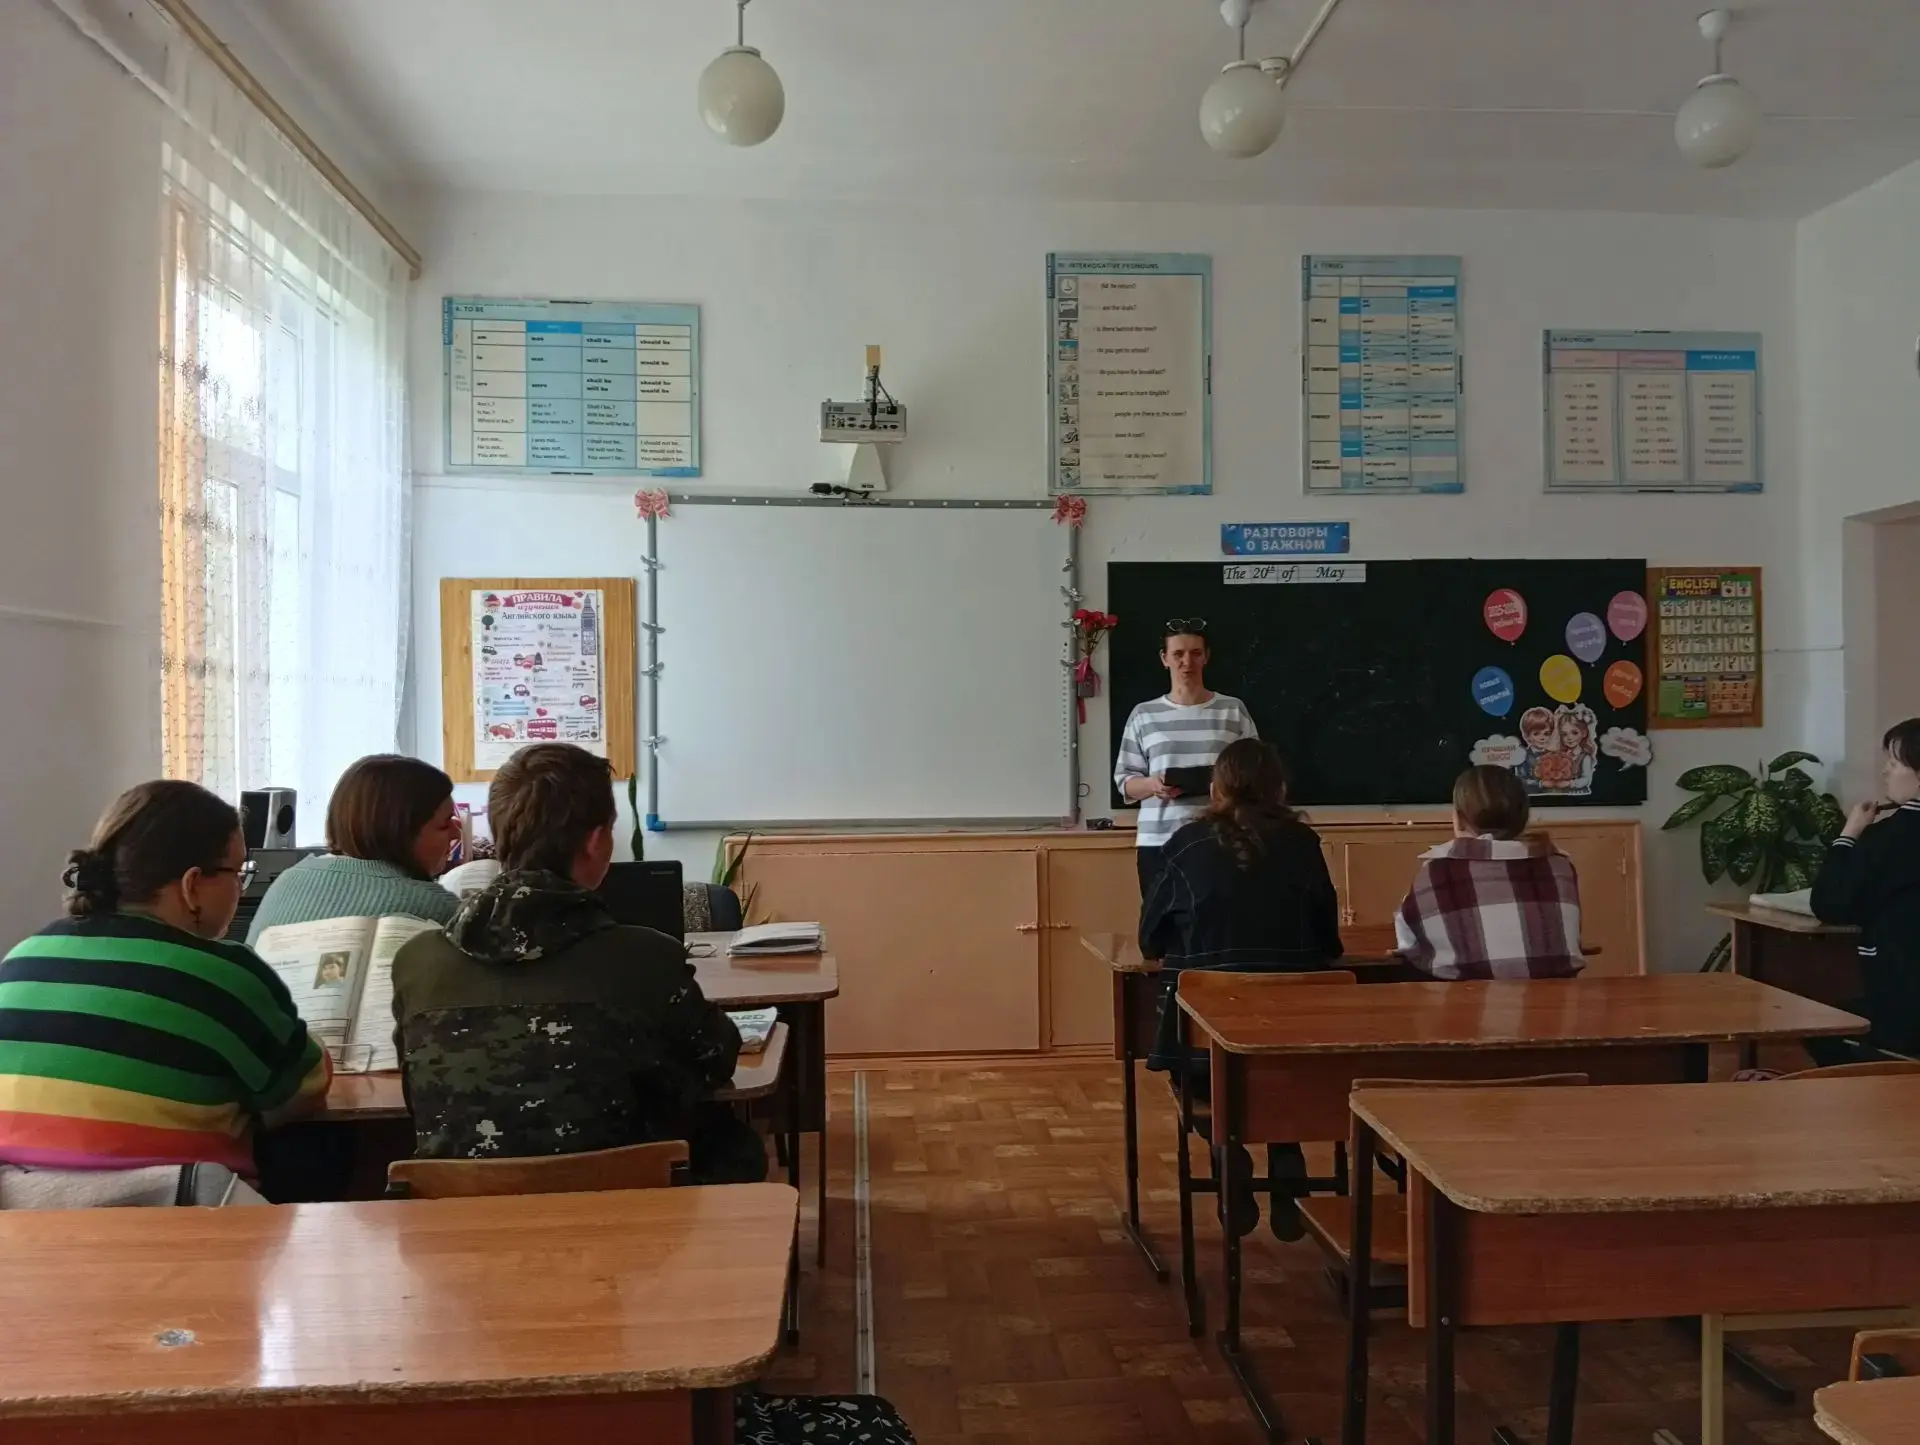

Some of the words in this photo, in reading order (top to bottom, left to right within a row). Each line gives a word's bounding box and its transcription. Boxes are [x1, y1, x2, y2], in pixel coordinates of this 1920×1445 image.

[1243, 527, 1328, 540] РАЗГОВОРЫ
[1246, 541, 1255, 551] О
[1261, 539, 1326, 551] ВАЖНОМ
[1223, 566, 1246, 579] The
[1281, 565, 1297, 582] of
[1316, 565, 1345, 582] May
[1669, 578, 1718, 589] ENGLISH
[512, 593, 563, 604] ПРАВИЛА
[502, 611, 551, 620] Английского
